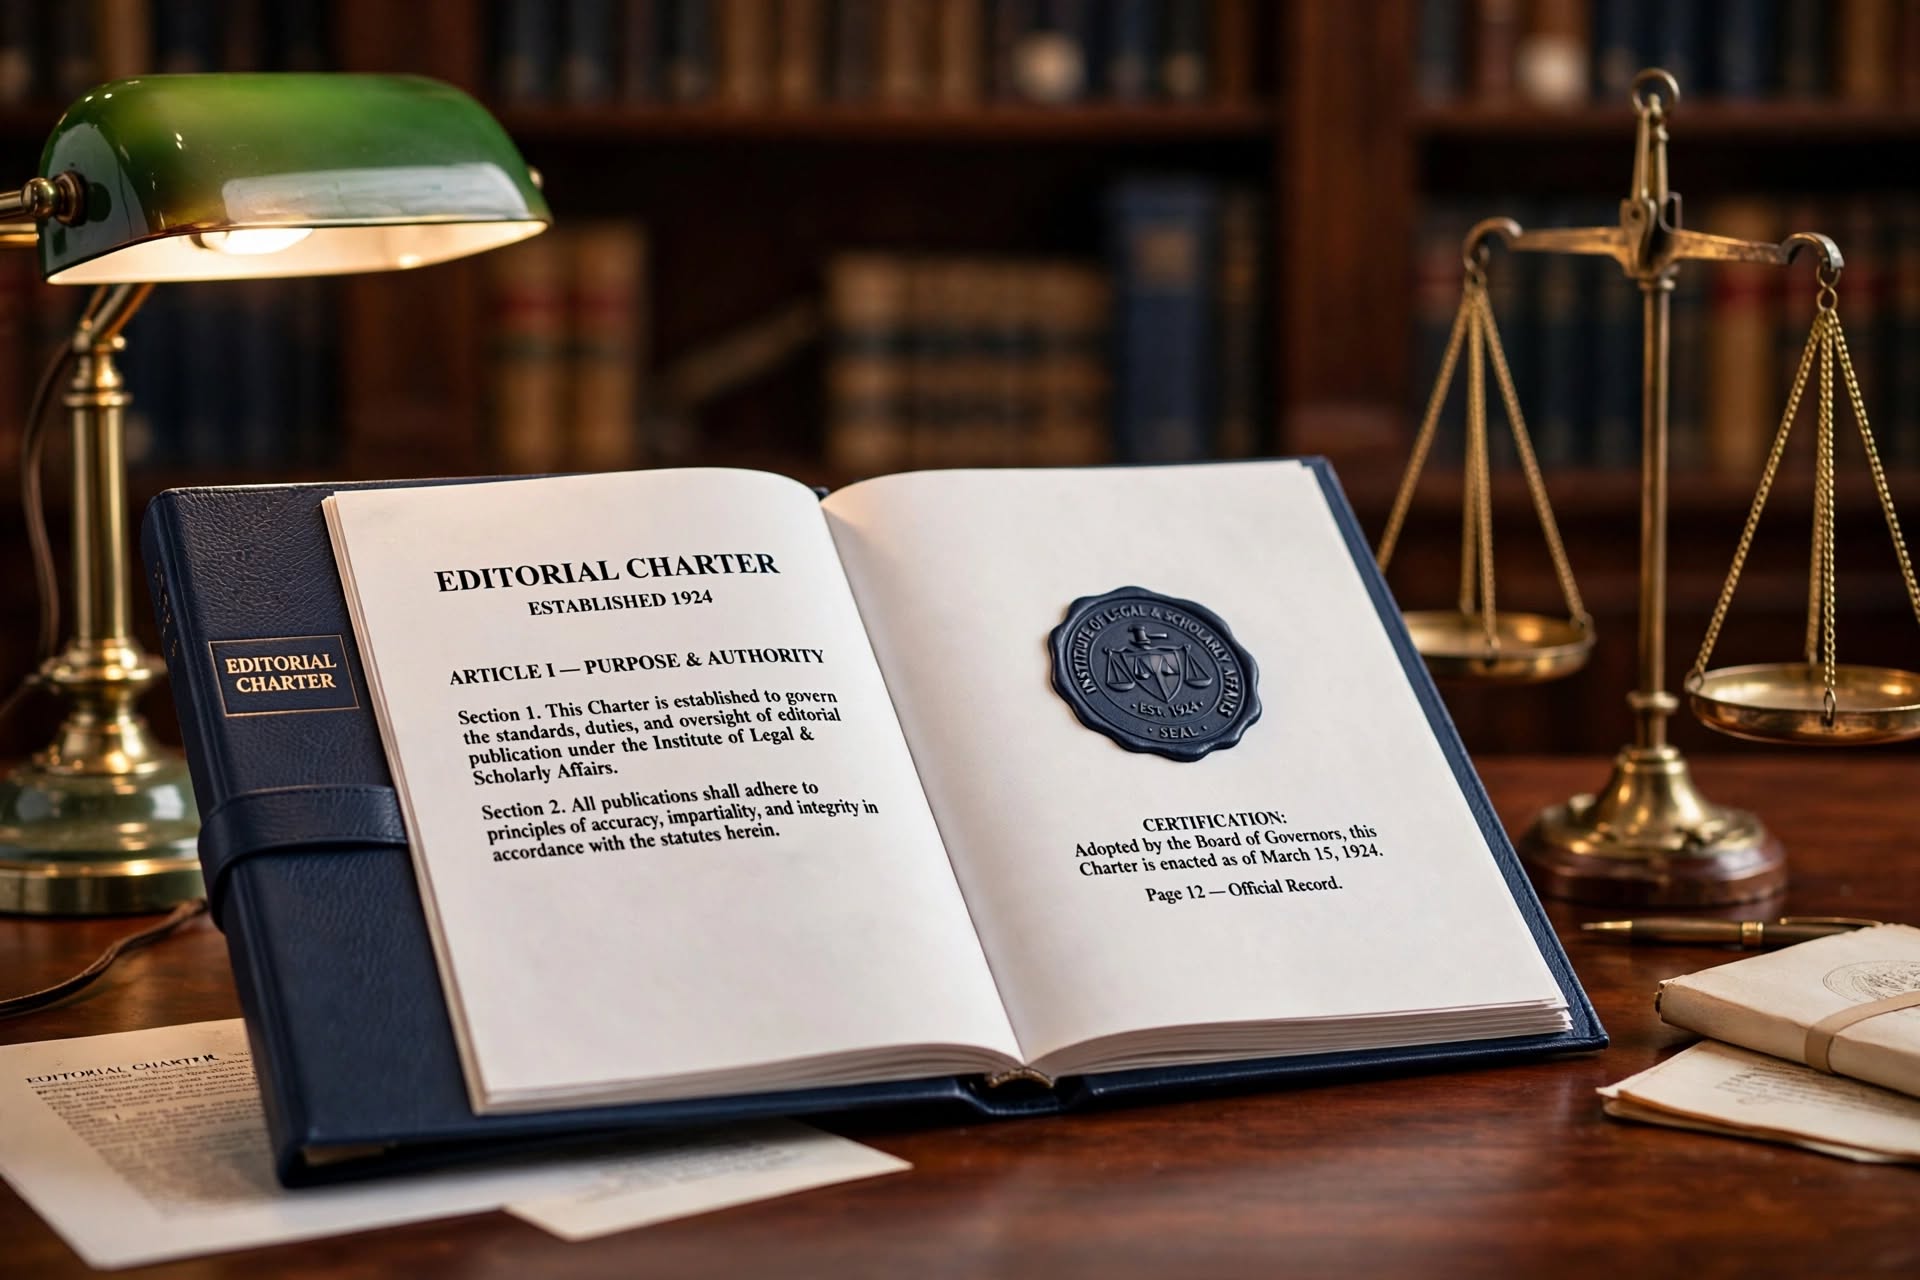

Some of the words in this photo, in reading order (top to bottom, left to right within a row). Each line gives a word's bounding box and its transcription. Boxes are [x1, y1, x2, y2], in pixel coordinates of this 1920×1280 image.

[434, 560, 620, 592] EDITORIAL
[626, 554, 780, 579] CHARTER
[528, 593, 666, 616] ESTABLISHED
[671, 589, 713, 605] 1924
[1089, 615, 1107, 630] OF
[1104, 604, 1147, 622] LEGAL
[1151, 607, 1161, 619] &
[1164, 610, 1232, 662] SCHOLARLY
[225, 654, 337, 674] EDITORIAL
[450, 664, 542, 685] ARTICLE
[546, 663, 555, 677] I
[584, 653, 681, 675] PURPOSE
[686, 652, 702, 667] &
[708, 648, 823, 665] AUTHORITY
[236, 673, 336, 693] CHARTER
[458, 708, 520, 725] Section
[526, 706, 541, 720] 1.
[545, 702, 583, 718] This
[587, 699, 650, 715] Charter
[654, 696, 669, 710] is
[674, 689, 760, 708] established
[764, 690, 781, 703] to
[785, 692, 838, 706] govern
[463, 729, 490, 745] the
[496, 723, 580, 742] standards,
[585, 719, 639, 735] duties,
[643, 714, 674, 730] and
[679, 709, 752, 728] oversight
[756, 707, 772, 722] of
[778, 706, 841, 721] editorial
[1160, 726, 1200, 739] SEAL
[468, 745, 563, 769] publication
[568, 740, 615, 757] under
[621, 737, 648, 752] the
[652, 733, 723, 750] Institute
[728, 728, 744, 744] of
[749, 726, 795, 745] Legal
[800, 726, 814, 741] &
[473, 765, 551, 785] Scholarly
[558, 761, 618, 779] Affairs.
[482, 802, 544, 820] Section
[549, 799, 566, 814] 2.
[572, 796, 596, 813] All
[601, 789, 698, 814] publications
[703, 783, 740, 801] shall
[745, 781, 798, 797] adhere
[802, 782, 819, 794] to
[487, 820, 566, 846] principles
[570, 817, 586, 833] of
[591, 815, 664, 831] accuracy,
[668, 803, 762, 827] impartiality,
[765, 800, 794, 816] and
[796, 799, 858, 817] integrity
[862, 799, 879, 814] in
[1143, 811, 1287, 832] CERTIFICATION:
[493, 842, 584, 862] accordance
[588, 834, 625, 852] with
[629, 833, 656, 849] the
[660, 830, 722, 846] statutes
[724, 825, 780, 840] herein.
[1075, 838, 1140, 858] Adopted
[1142, 838, 1161, 855] by
[1167, 836, 1191, 850] the
[1194, 832, 1242, 848] Board
[1246, 830, 1261, 845] of
[1264, 830, 1347, 844] Governors,
[1349, 824, 1377, 839] this
[1079, 861, 1138, 876] Charter
[1142, 858, 1156, 871] is
[1160, 853, 1218, 870] enacted
[1222, 856, 1238, 866] as
[1242, 850, 1257, 865] of
[1260, 847, 1311, 864] March
[1314, 846, 1339, 861] 15,
[1342, 843, 1383, 858] 1924.
[1145, 888, 1183, 904] Page
[1186, 885, 1206, 899] 12
[1228, 879, 1283, 896] Official
[1285, 876, 1343, 892] Record.
